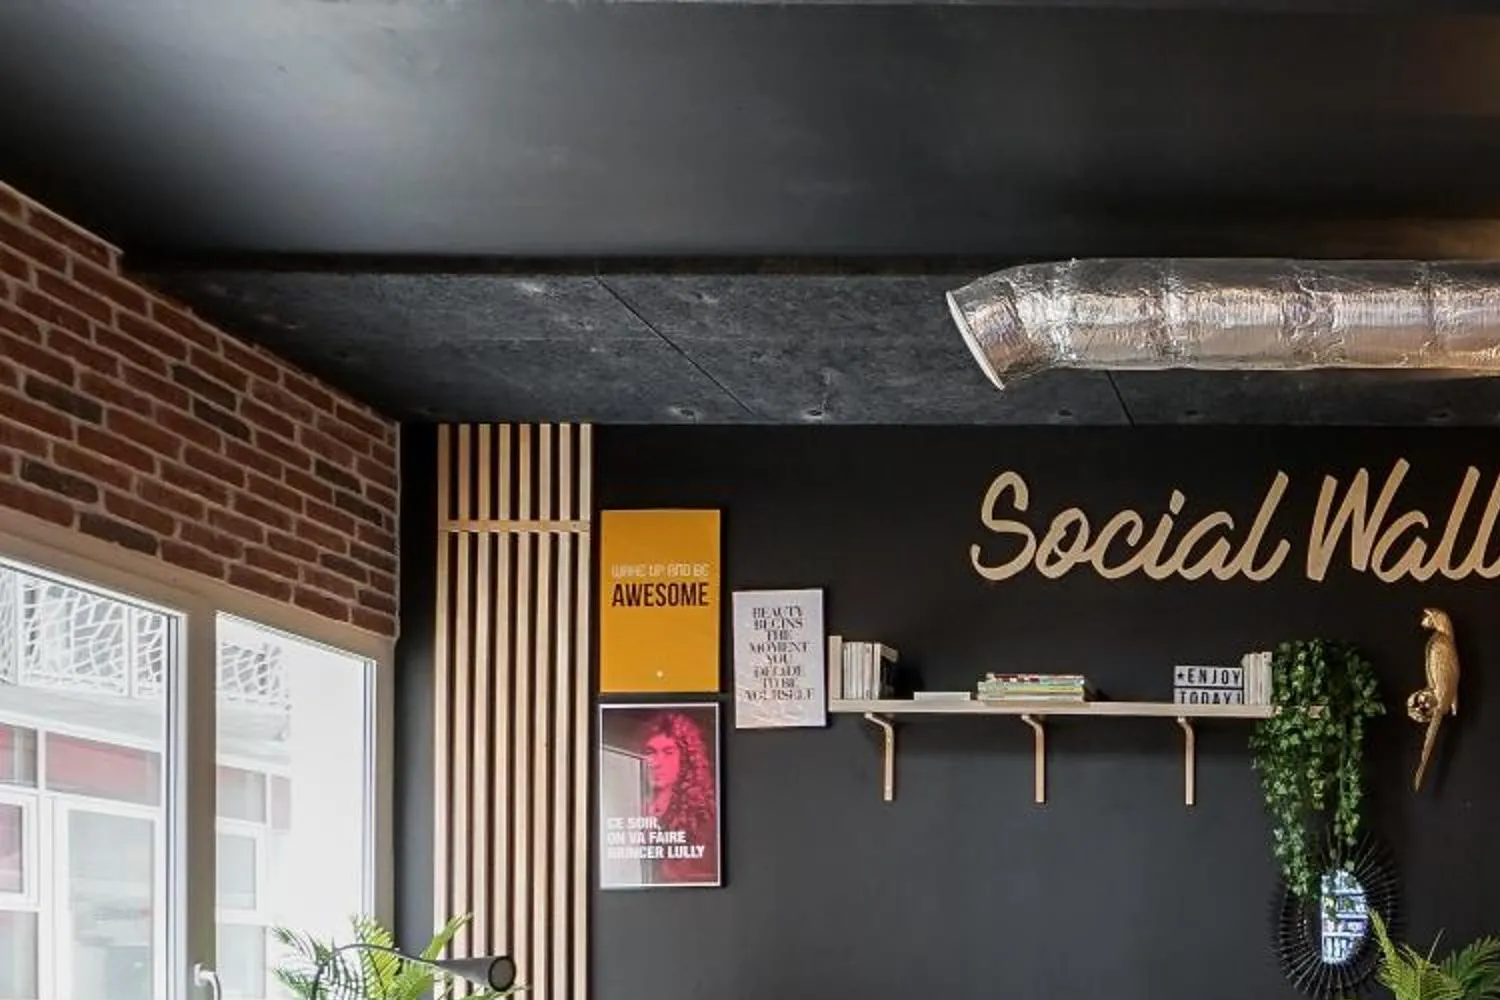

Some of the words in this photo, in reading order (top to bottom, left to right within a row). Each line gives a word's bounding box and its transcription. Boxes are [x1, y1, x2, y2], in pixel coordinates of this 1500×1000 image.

[970, 471, 1290, 581] Social
[649, 563, 666, 577] UP
[693, 563, 709, 577] BE
[611, 582, 709, 607] AWESOME
[752, 606, 803, 618] BEAUTY
[753, 619, 803, 630] BEGINS
[766, 630, 791, 641] THE
[749, 642, 809, 653] MOMENT
[766, 654, 790, 664] YOU
[1187, 668, 1240, 684] ENJOY
[744, 688, 814, 700] YOURSELF
[607, 817, 624, 829] CE
[627, 816, 661, 830] SOIR,
[607, 831, 625, 844] ON
[628, 831, 646, 844] VA
[649, 831, 687, 843] FAIRE
[667, 845, 705, 859] LULLY
